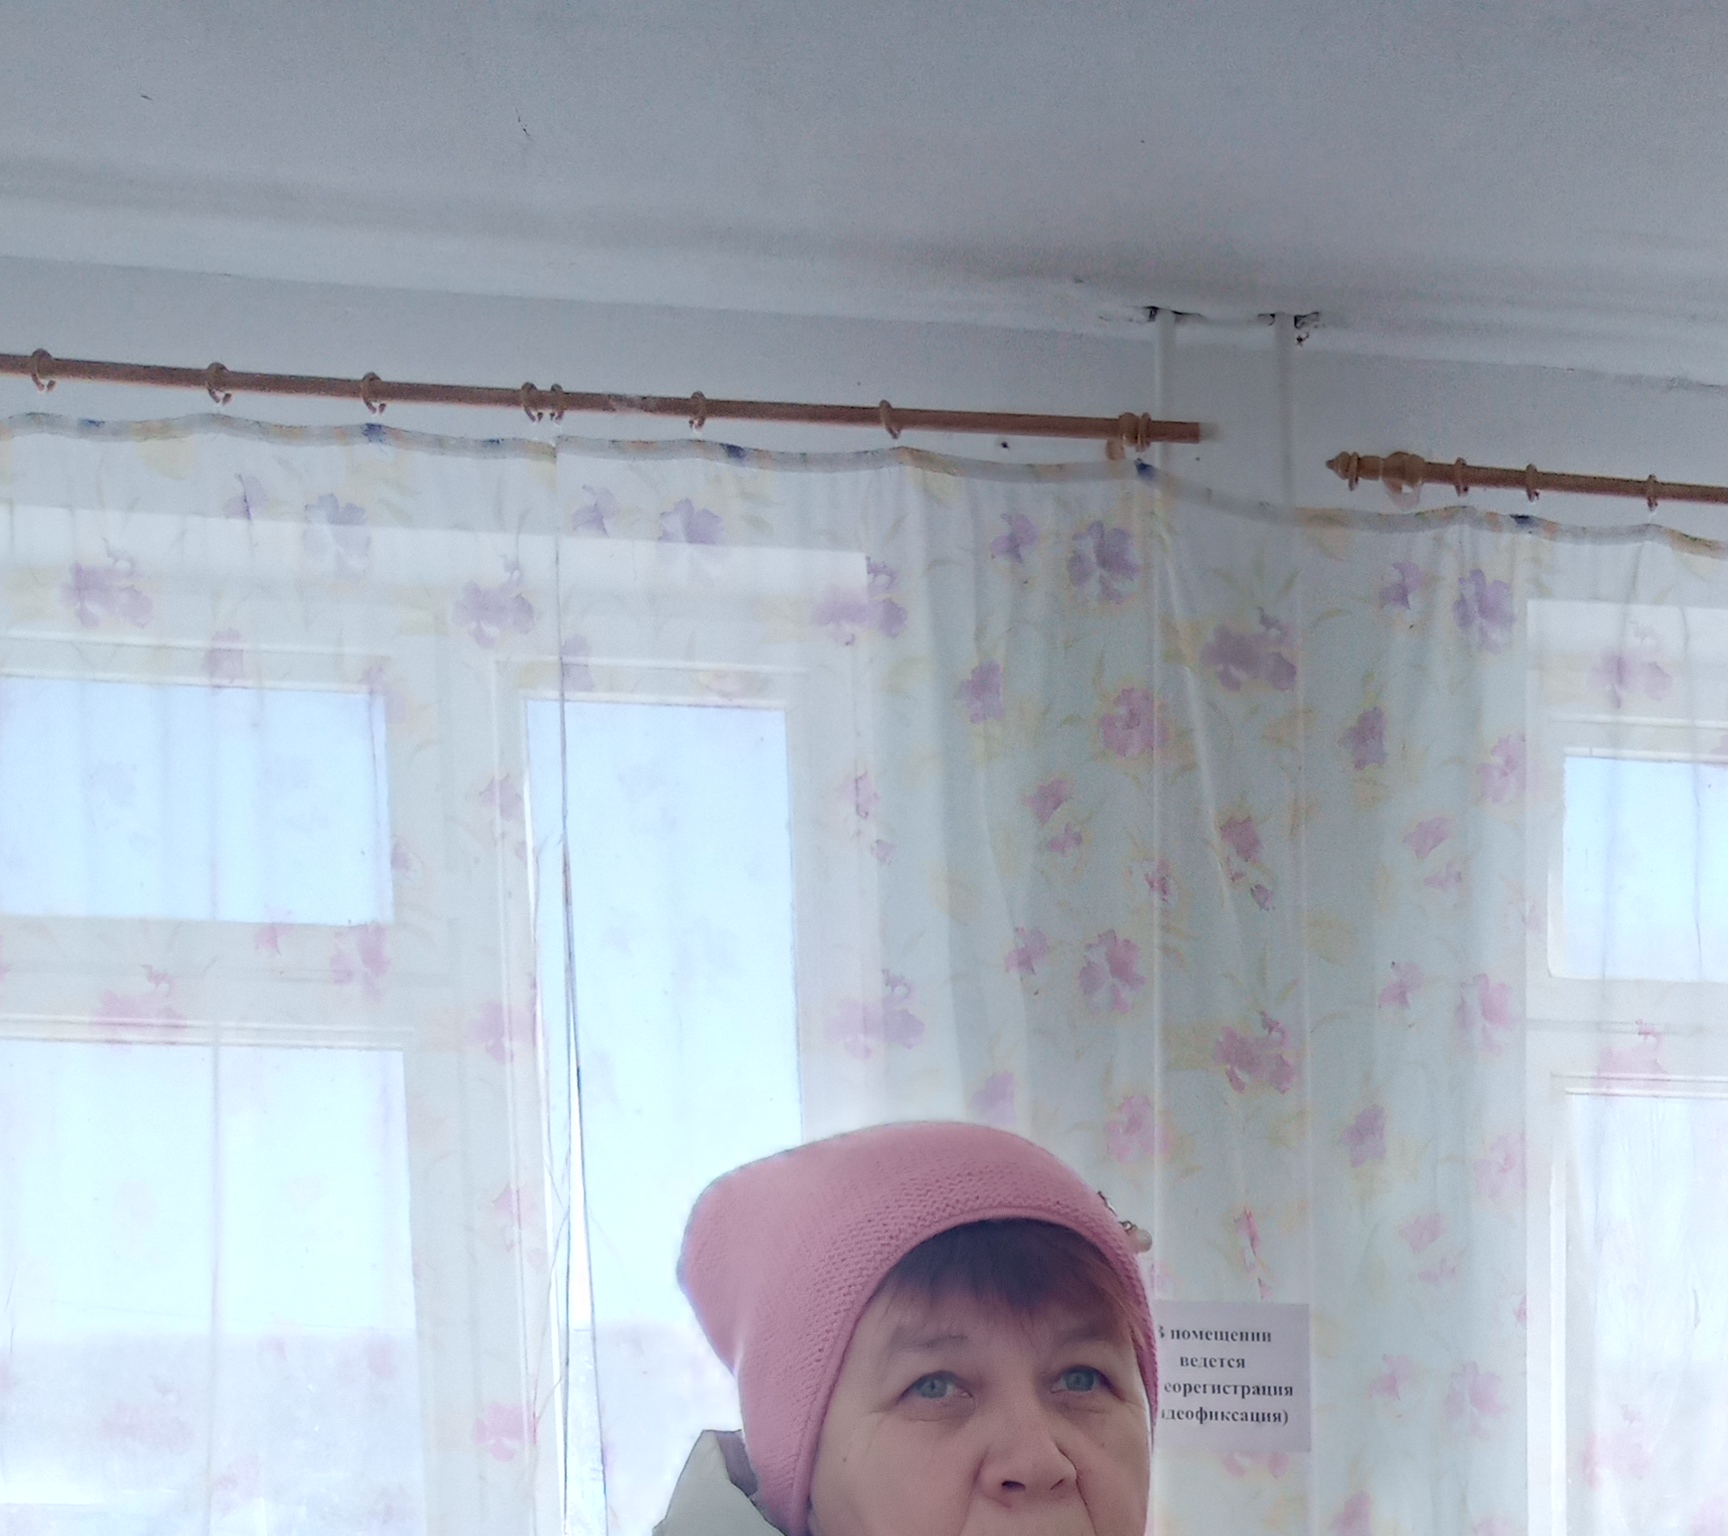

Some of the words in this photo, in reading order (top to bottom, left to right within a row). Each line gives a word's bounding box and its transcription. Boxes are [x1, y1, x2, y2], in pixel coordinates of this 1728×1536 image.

[1170, 1328, 1272, 1344] помещении
[1180, 1356, 1246, 1369] ведется
[1164, 1381, 1294, 1399] еорегистрация
[1161, 1406, 1289, 1426] деофиксация)
